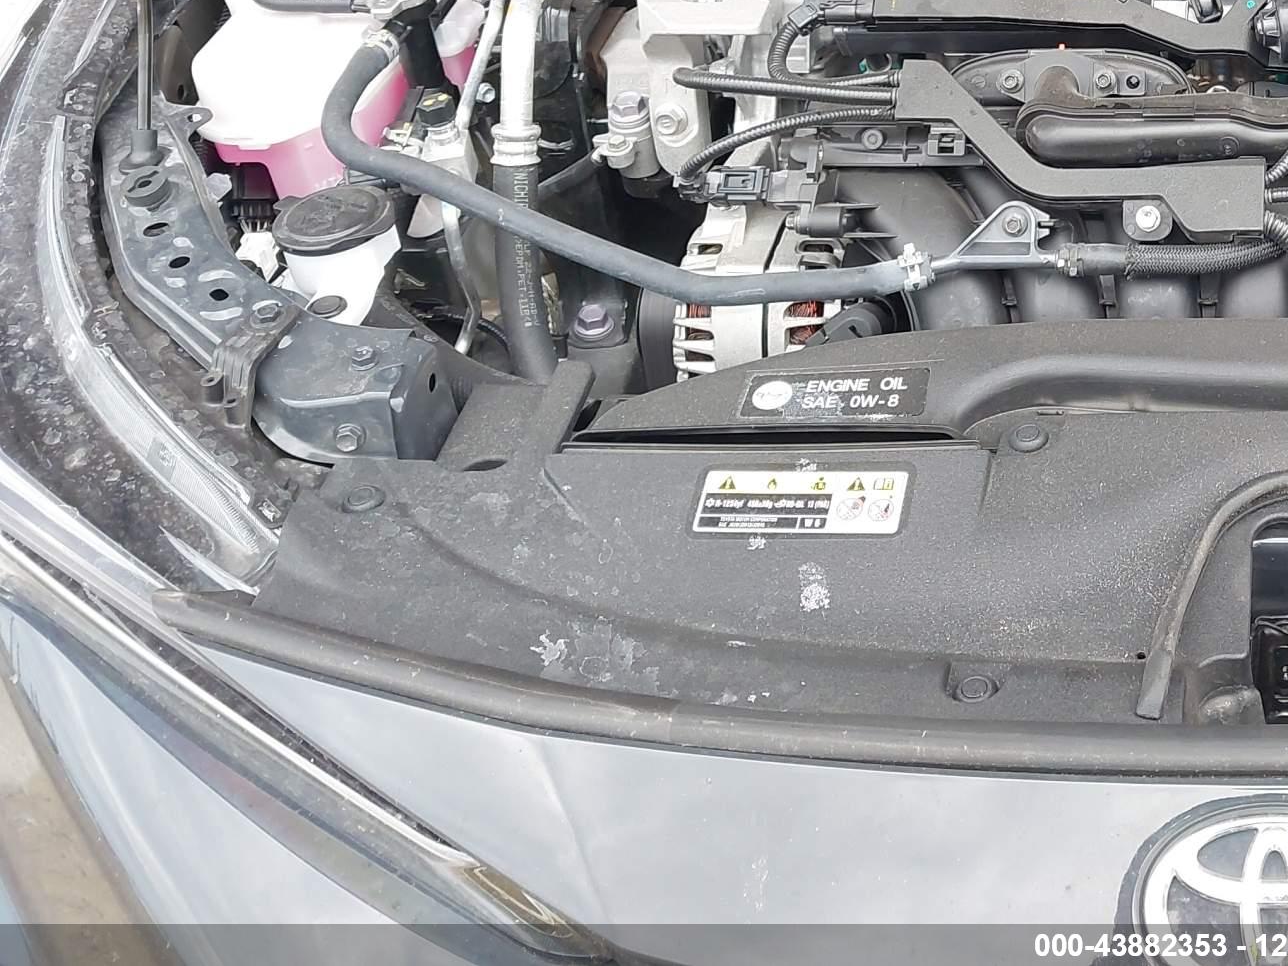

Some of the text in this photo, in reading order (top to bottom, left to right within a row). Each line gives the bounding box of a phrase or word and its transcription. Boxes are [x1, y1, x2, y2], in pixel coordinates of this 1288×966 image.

[805, 376, 908, 393] ENGINE OIL
[801, 394, 899, 409] SAE 0W-8
